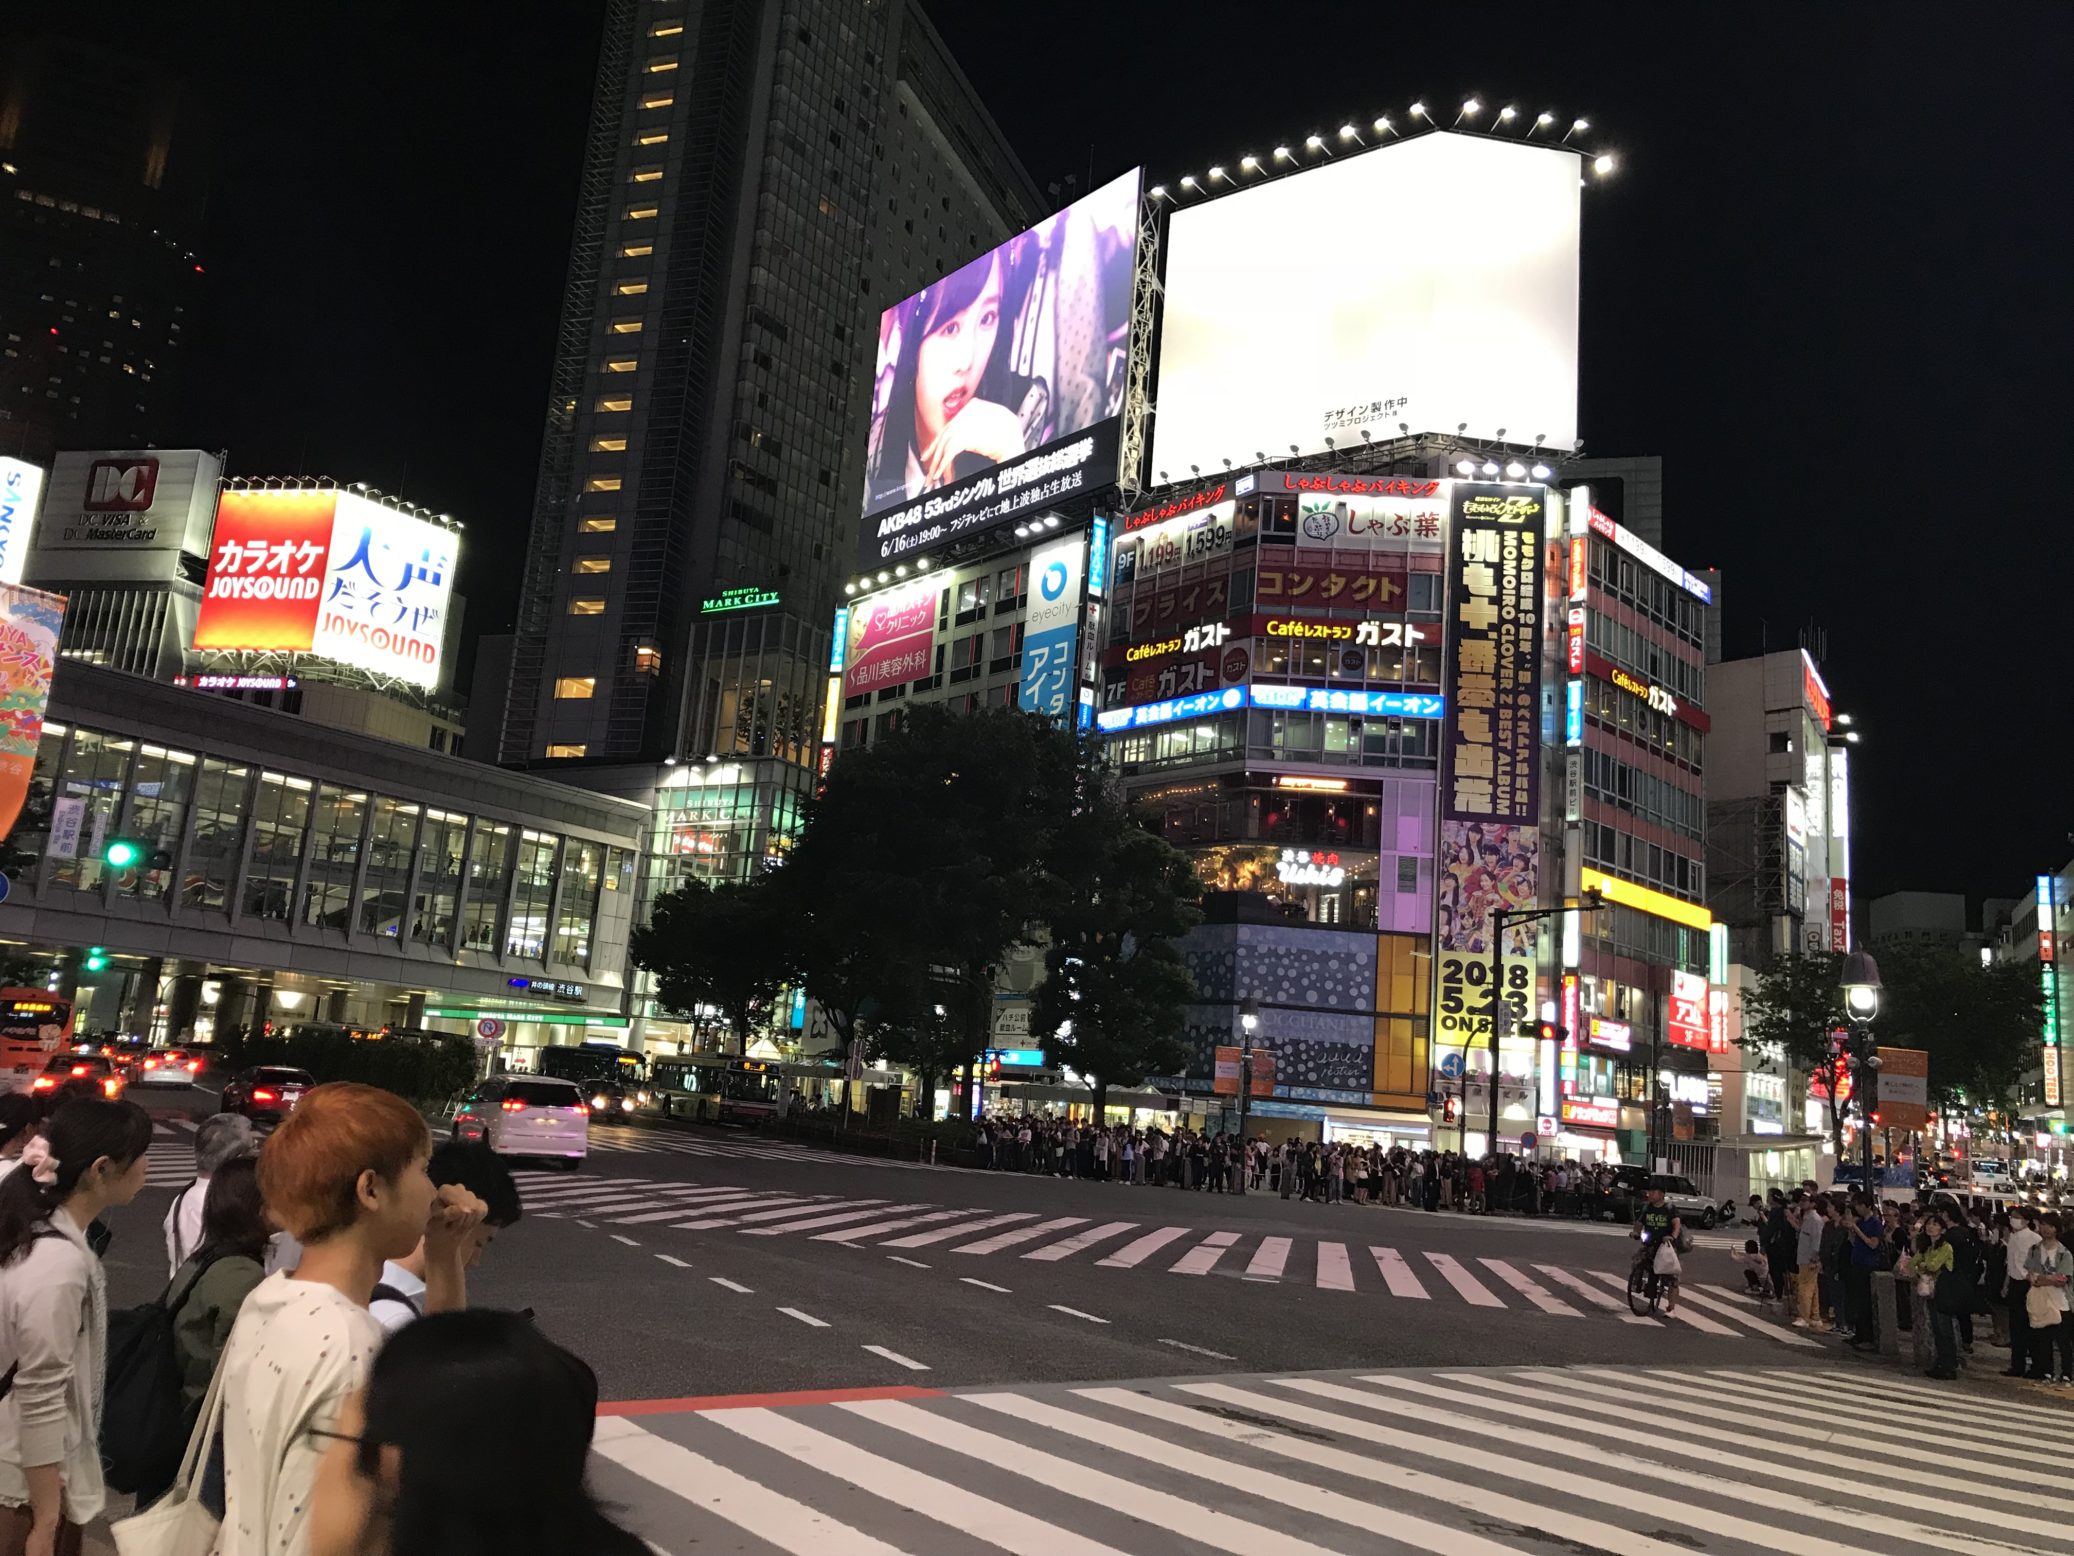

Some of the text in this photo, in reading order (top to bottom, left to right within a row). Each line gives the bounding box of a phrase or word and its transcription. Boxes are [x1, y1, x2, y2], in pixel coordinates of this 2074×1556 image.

[1323, 396, 1408, 422] デザイン製作中
[1284, 473, 1440, 497] しゃぶしゃぶバイキング
[877, 509, 922, 538] AKB48
[924, 477, 997, 520] 53rdシングル
[950, 470, 1083, 533] フジテレビにて地上波独占生放送
[1124, 484, 1227, 530] しゃぶしゃぶバイキング
[78, 513, 99, 527] DC
[102, 513, 132, 526] VISA
[1348, 509, 1440, 539] しゃぶ葉
[87, 528, 158, 541] MasterCard
[214, 539, 325, 574] カラオケ
[1118, 550, 1135, 570] 9F
[208, 575, 320, 600] JOYSOUND
[722, 587, 759, 597] SHIBUYA
[1257, 571, 1403, 602] コンタクト
[702, 591, 778, 610] MARK CITY
[1031, 602, 1073, 625] eyecity
[886, 610, 927, 636] クリニック
[1355, 621, 1425, 648] ガスト
[322, 611, 436, 664] JOYSOUND
[1183, 622, 1231, 653] ガスト
[856, 648, 928, 687] 品川美容外科
[1226, 661, 1246, 673] ガスト
[1496, 530, 1518, 816] MOMOIRO CLOVER Z BEST ALBUM
[198, 676, 236, 688] カラオケ
[237, 676, 281, 689] JOYSOUND
[1107, 681, 1127, 702] 7F
[1131, 674, 1156, 692] Café
[1157, 661, 1215, 699] ガスト
[1648, 685, 1677, 717] ガスト
[1568, 760, 1578, 816] 渋谷駅前ビル
[663, 808, 712, 823] MARK
[686, 799, 735, 809] SHIBUYA
[1311, 852, 1340, 866] 焼肉
[1442, 958, 1529, 990] 2018
[556, 983, 583, 996] 渋谷駅
[1440, 985, 1529, 1020] 5.23
[526, 1013, 544, 1022] CITY
[1002, 1013, 1027, 1022] ハチ公前
[1440, 1014, 1473, 1032] ON
[1676, 1000, 1704, 1026] アコム
[2045, 1052, 2058, 1100] HOOTERS
